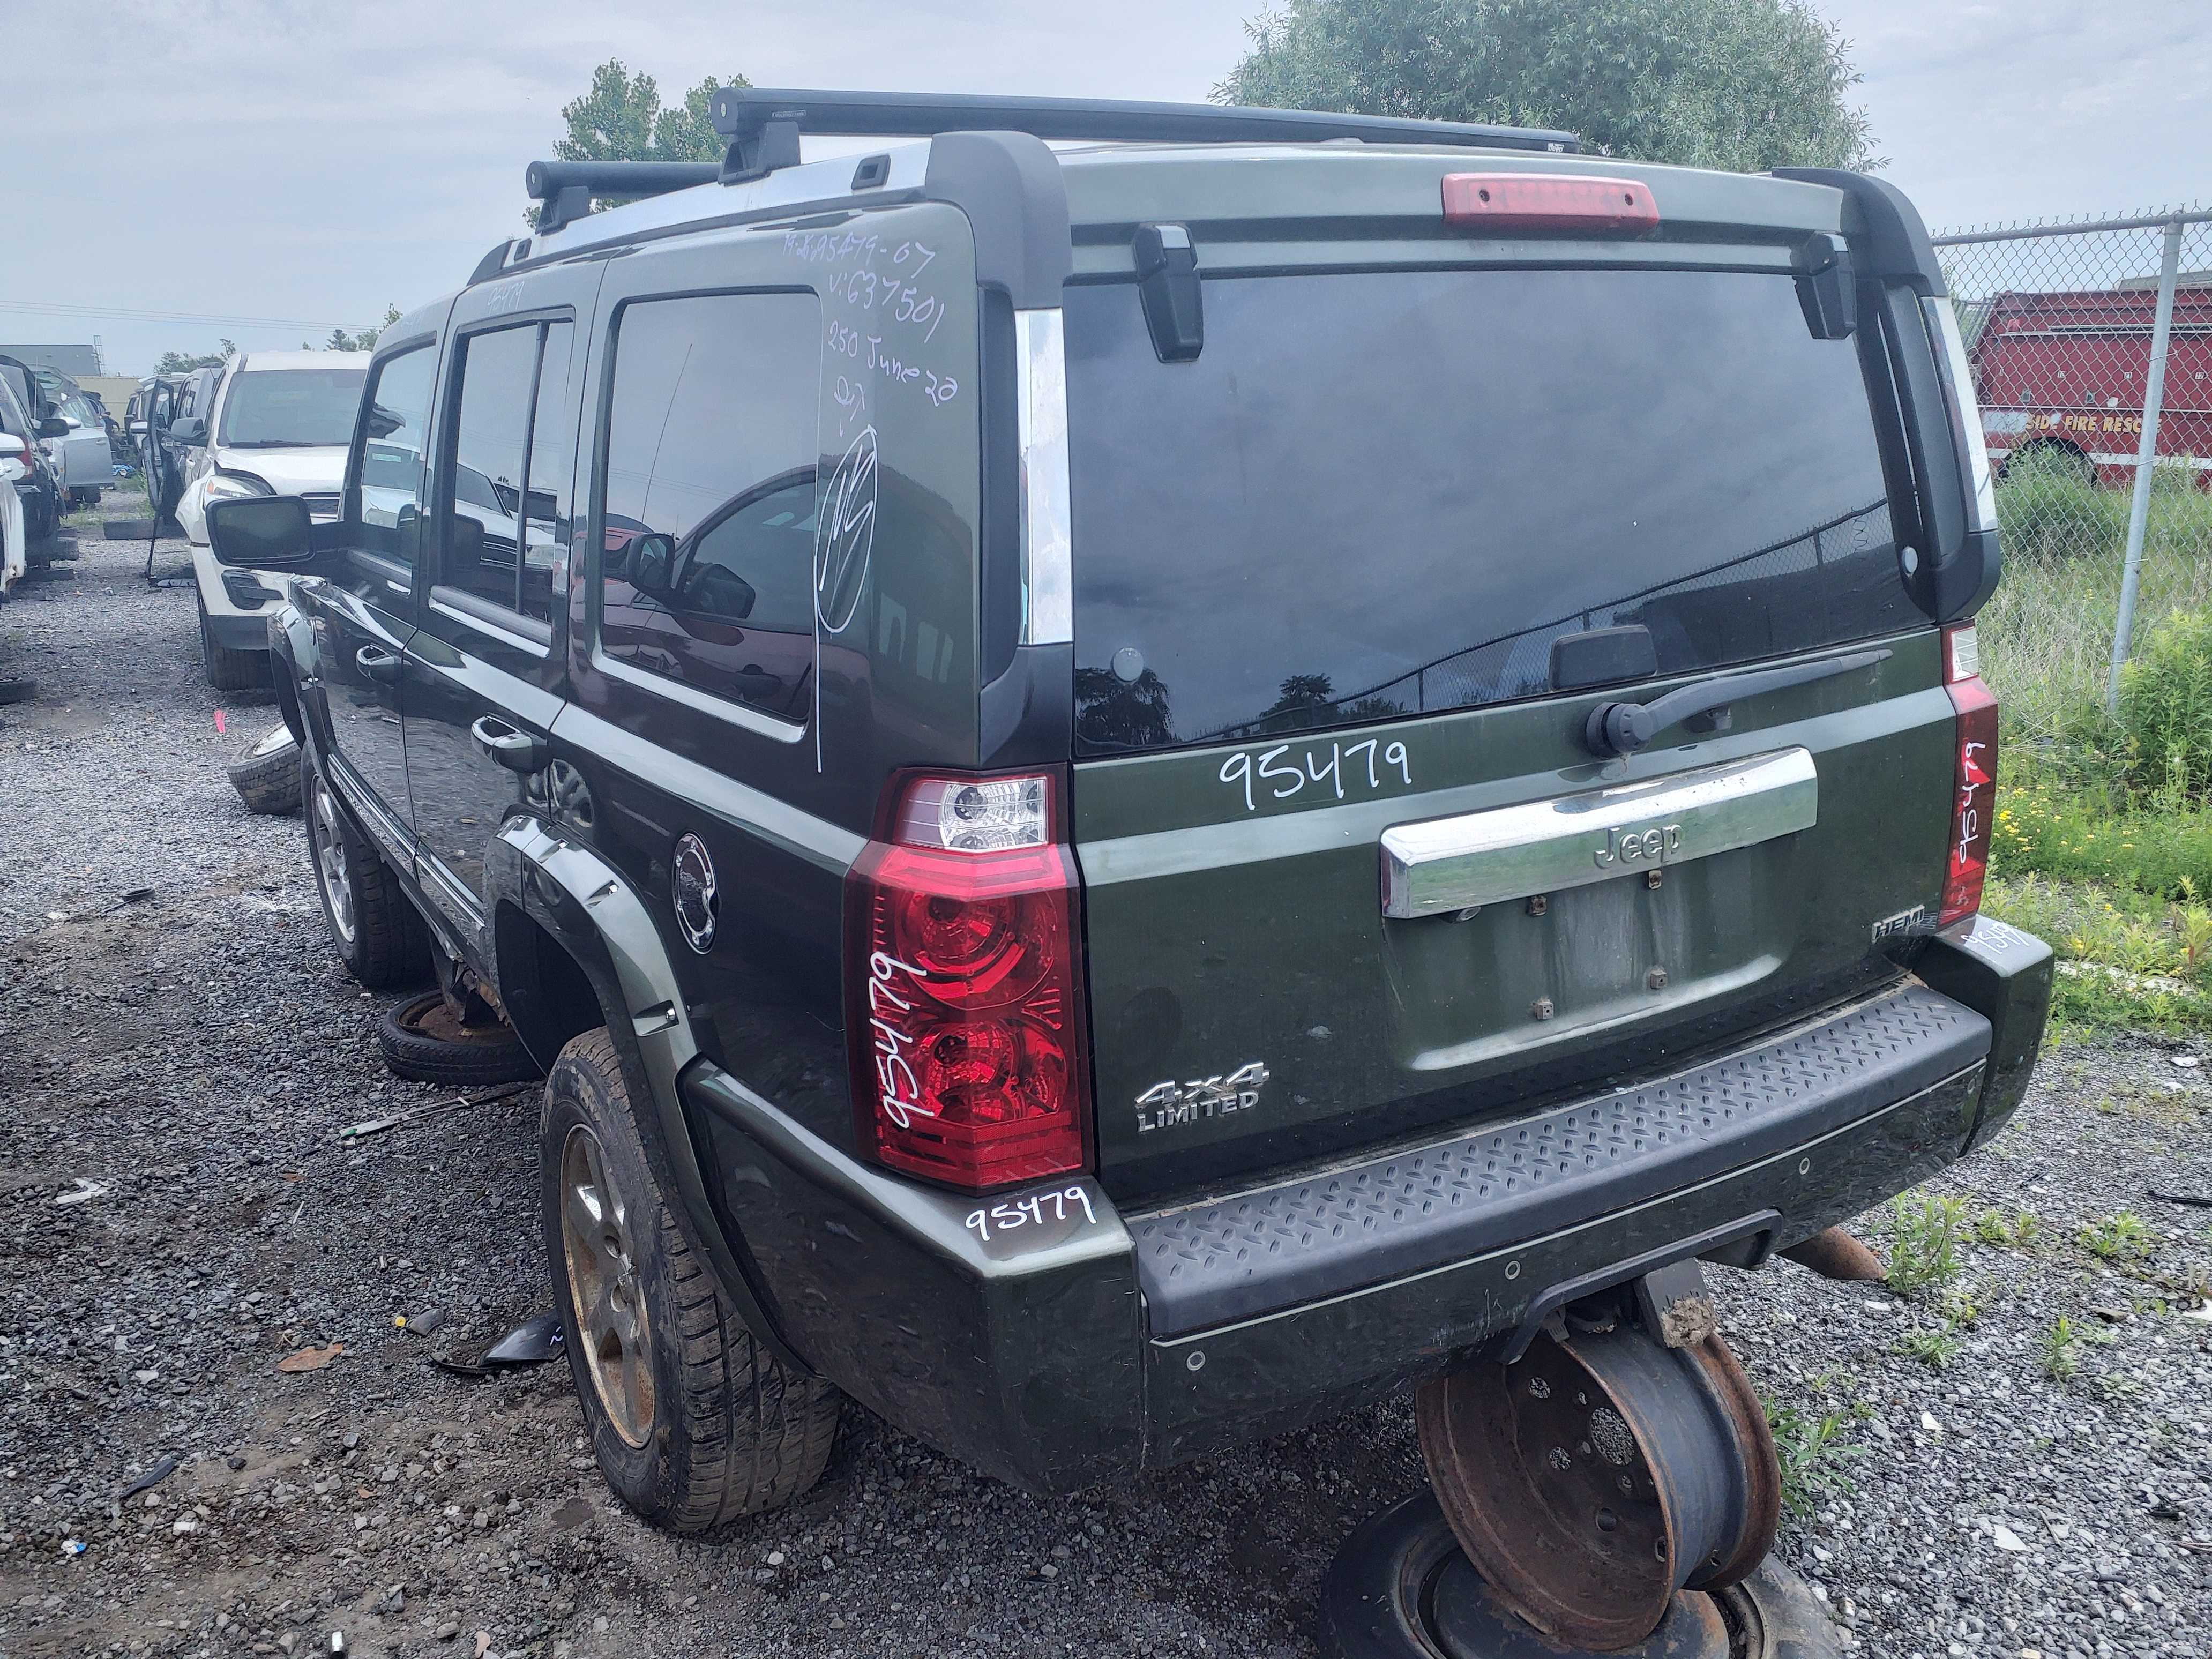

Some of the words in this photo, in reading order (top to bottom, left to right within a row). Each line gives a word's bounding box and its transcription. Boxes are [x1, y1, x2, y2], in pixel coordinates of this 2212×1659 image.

[828, 320, 858, 357] 250
[867, 335, 920, 383] June
[2065, 415, 2097, 431] FIRE
[1219, 738, 1412, 811] 95479
[1959, 741, 1986, 864] 95479
[1594, 823, 1682, 869] Jeep
[1871, 904, 1925, 944] HEMI
[869, 951, 935, 1129] 95479
[1137, 1090, 1259, 1132] LIMITED
[965, 1185, 1097, 1242] 95479
